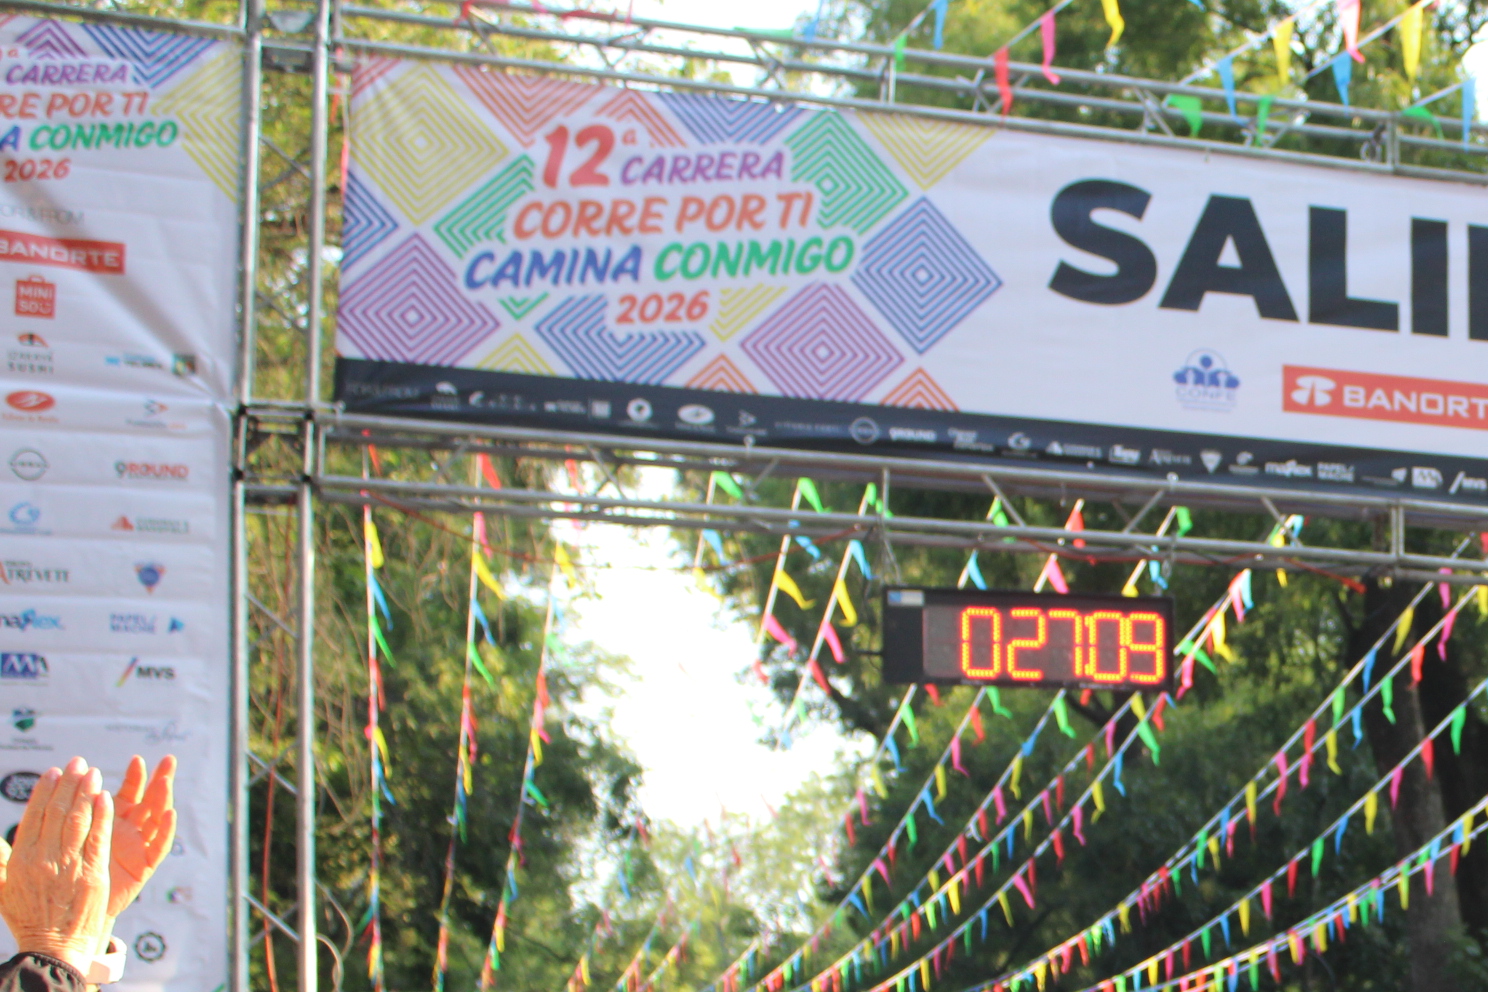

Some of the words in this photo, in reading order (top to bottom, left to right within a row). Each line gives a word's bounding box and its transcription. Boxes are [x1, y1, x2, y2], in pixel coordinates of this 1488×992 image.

[6, 63, 129, 86] CARRERA
[47, 92, 115, 119] POR
[122, 91, 150, 116] TI
[29, 120, 179, 151] CONMIGO
[4, 157, 72, 183] 2026
[620, 151, 786, 187] CARRERA
[513, 196, 667, 240] CORRE
[675, 193, 766, 237] POR
[777, 191, 815, 230] TI
[464, 244, 643, 290] CAMINA
[652, 235, 856, 281] CONMIGO
[19, 285, 54, 299] MINI
[615, 289, 710, 326] 2026
[1175, 386, 1237, 401] CONFE
[135, 665, 176, 680] MVS
